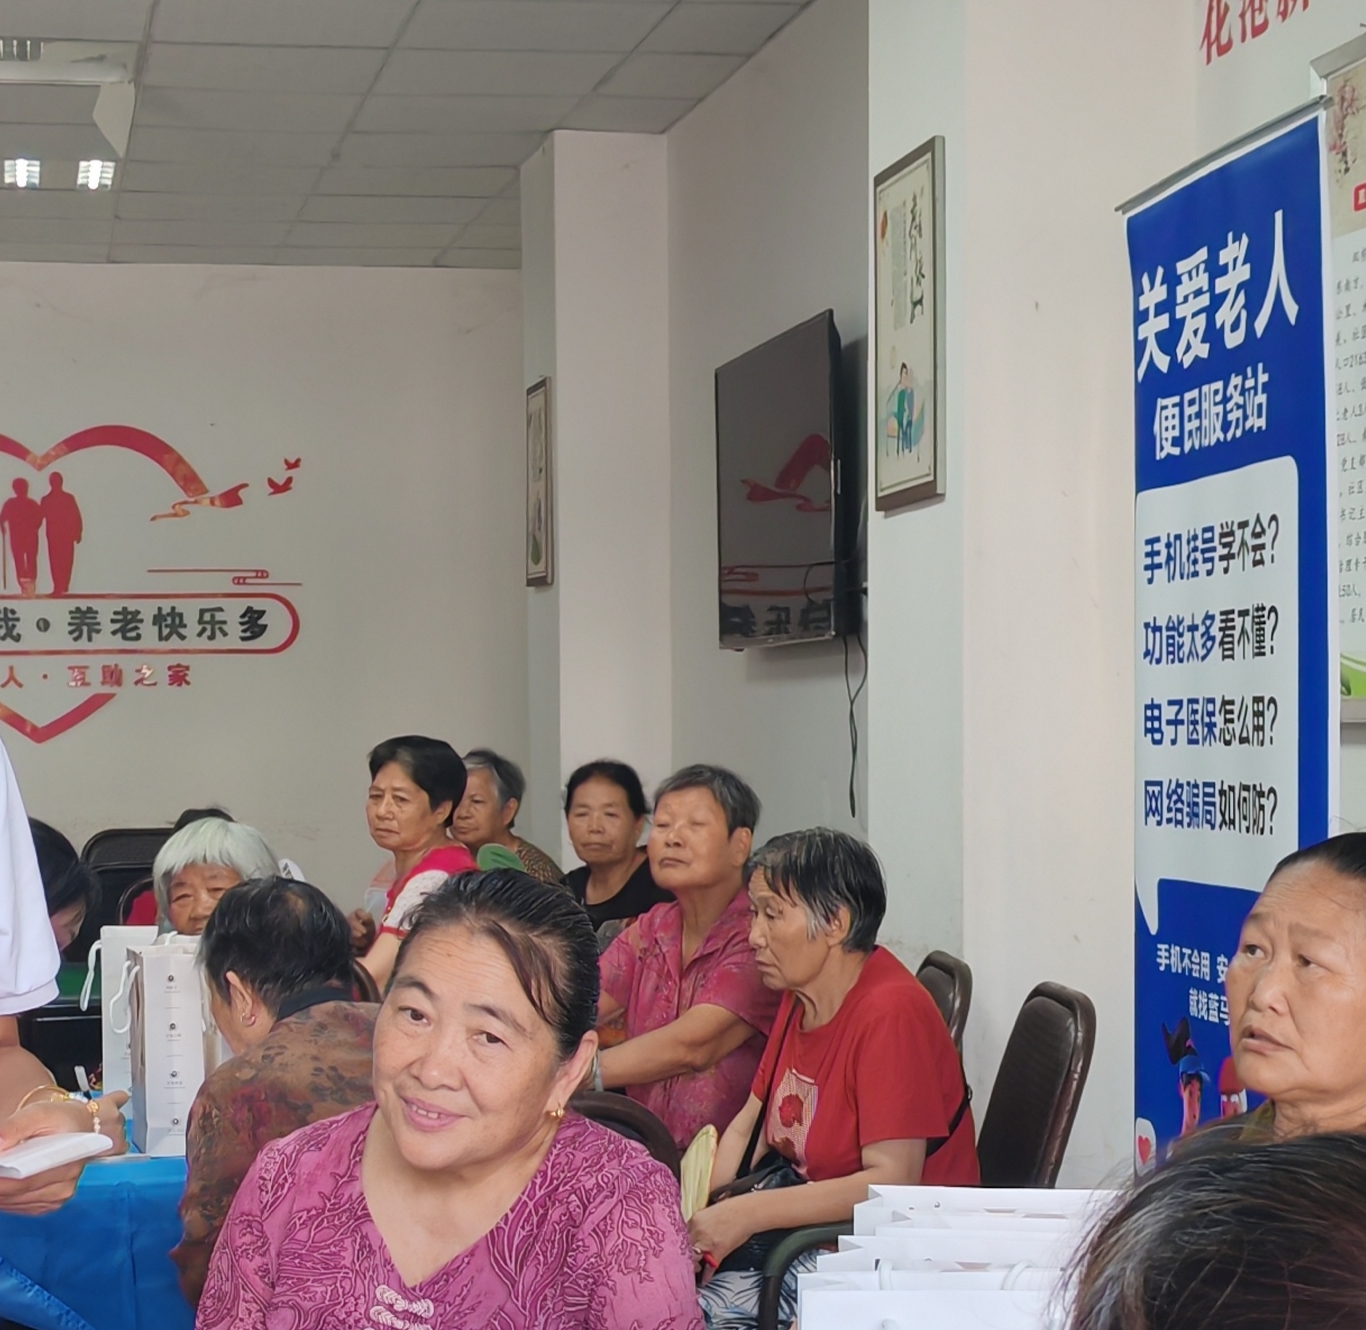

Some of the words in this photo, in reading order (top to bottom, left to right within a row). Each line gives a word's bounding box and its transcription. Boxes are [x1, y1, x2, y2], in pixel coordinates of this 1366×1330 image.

[1137, 209, 1299, 384] 关爱老人
[1153, 364, 1269, 460] 便民服务站
[1143, 513, 1281, 585] 手机挂号学不会？
[1143, 605, 1280, 666] 功能太多看不懂？
[1143, 695, 1279, 748] 电子医保怎么用？
[1143, 779, 1279, 836] 网络骗局如何防？
[1156, 943, 1211, 982] 手机不会用
